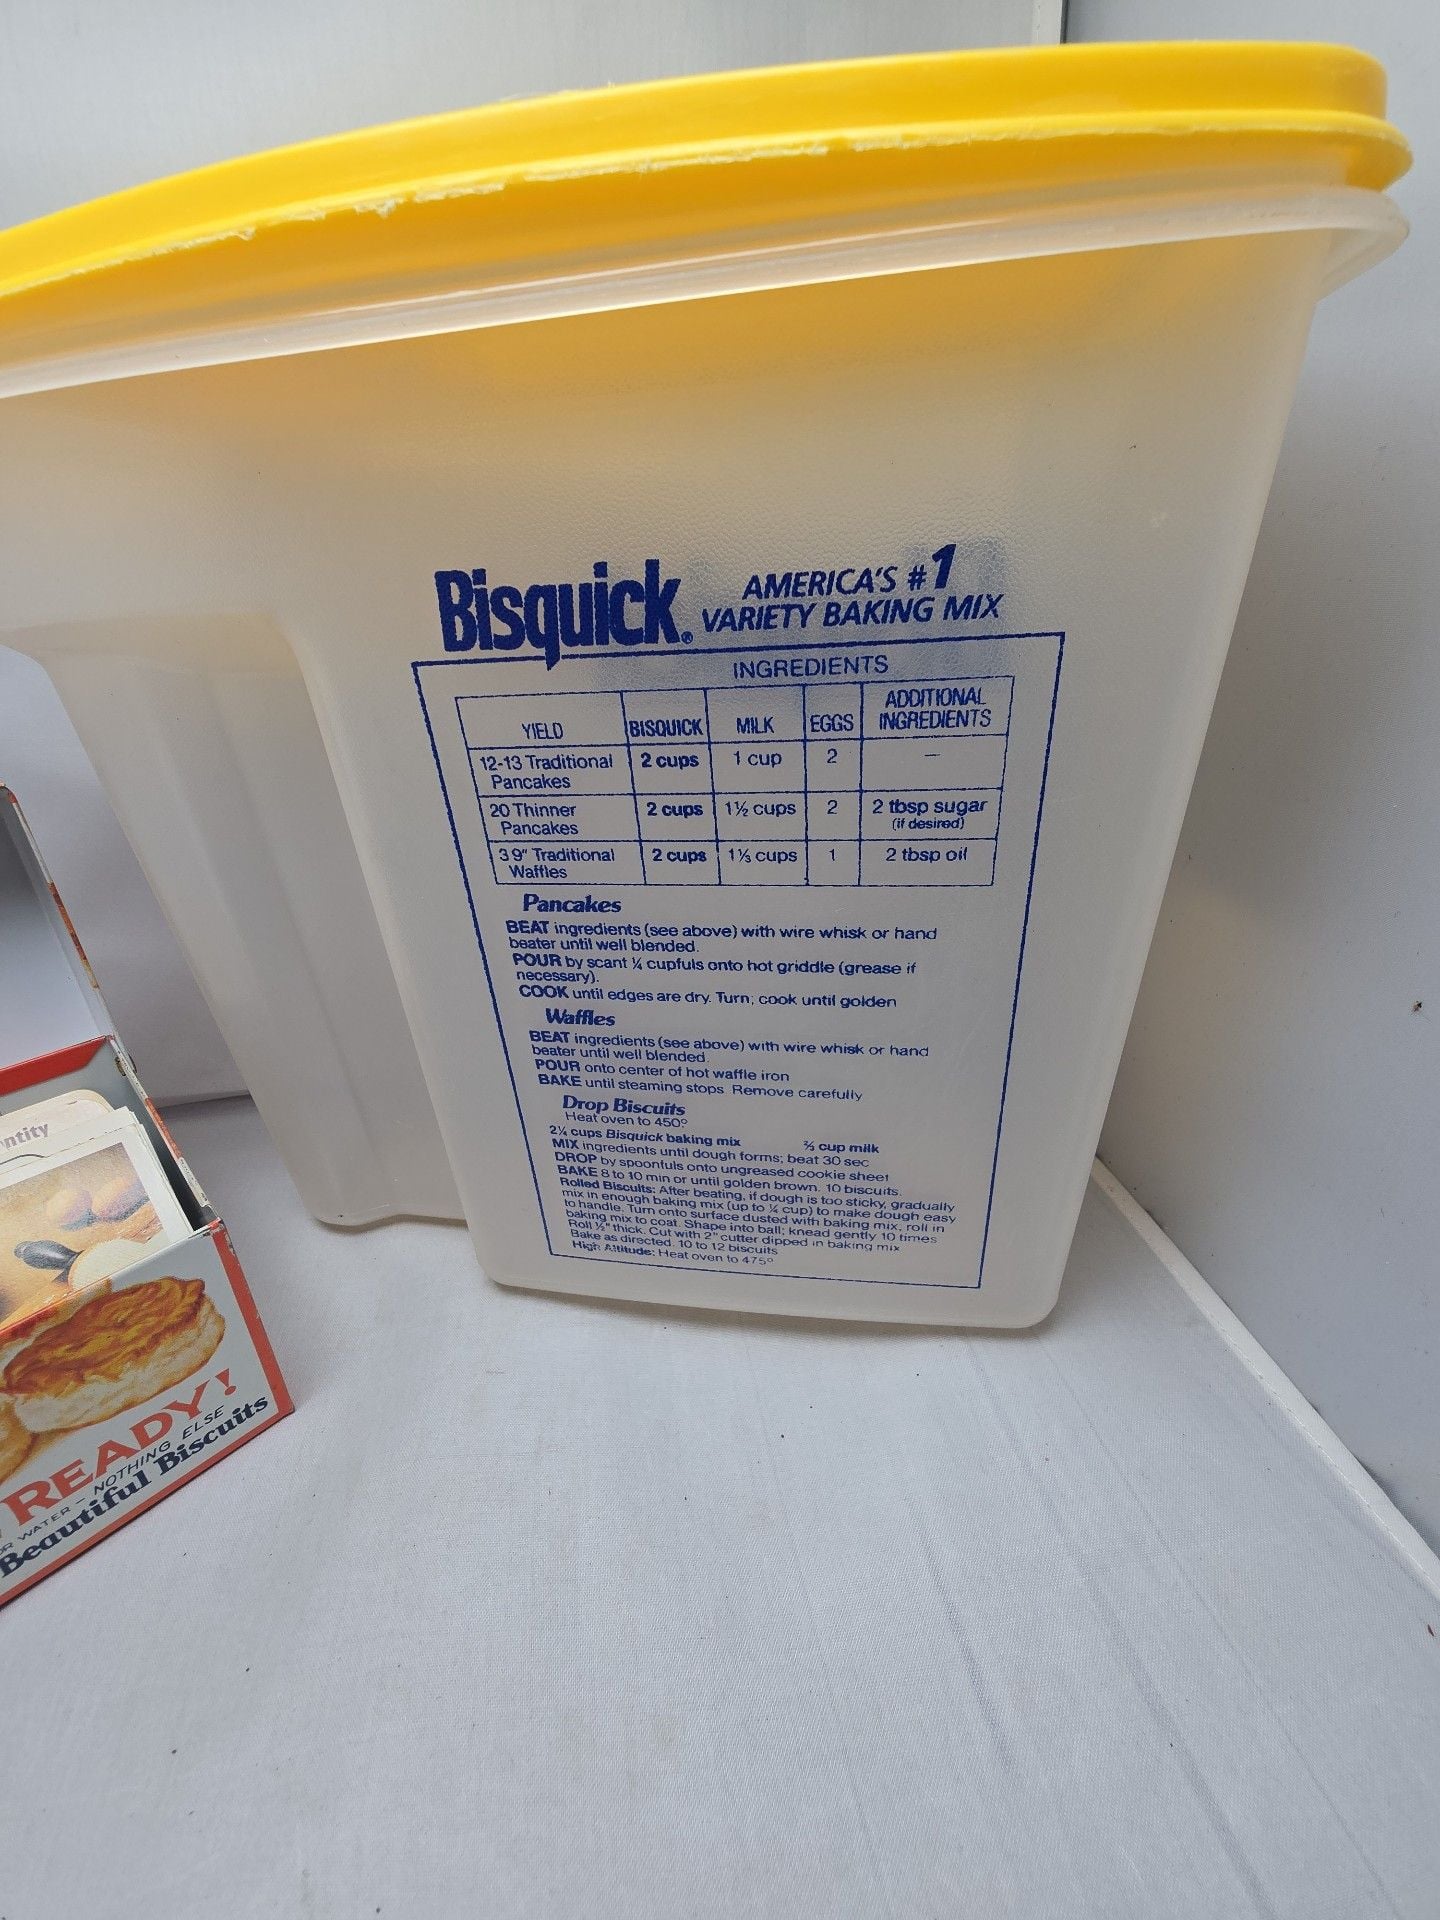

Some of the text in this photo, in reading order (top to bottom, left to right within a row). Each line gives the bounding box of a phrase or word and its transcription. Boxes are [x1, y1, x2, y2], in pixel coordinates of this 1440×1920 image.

[742, 543, 957, 600] AMERICA'S #1
[701, 594, 1005, 632] VARIETY BAKING MIX
[733, 655, 889, 679] INGREDIENTS
[885, 687, 987, 709] ADDITIONAL
[628, 718, 704, 738] BISQUICK
[736, 715, 775, 735] MILK
[810, 714, 854, 733] EGGS
[879, 708, 992, 731] INGREDIENTS
[521, 722, 564, 739] YIELD
[480, 753, 613, 771] 12-13 Traditional
[640, 752, 699, 769] 2 cups
[734, 752, 783, 768] 1 cup
[826, 749, 838, 764] 2
[490, 773, 571, 790] Pancakes
[490, 803, 577, 818] 20 Thinner
[646, 802, 704, 817] 2 cups
[753, 803, 797, 817] cups
[827, 800, 839, 815] 2
[872, 799, 989, 815] 2 tbsp sugar
[500, 820, 579, 836] Pancakes
[892, 817, 966, 831] (if desired)
[533, 847, 615, 862] Traditional
[652, 849, 708, 863] 2 cups
[755, 851, 798, 864] cups
[829, 849, 836, 862] 1
[885, 847, 968, 864] 2 tbsp oil
[508, 864, 568, 879] Waffles
[523, 893, 621, 912] Pancakes
[506, 920, 936, 939] BEAT ingredients (see above) with wire whisk or hand
[509, 936, 556, 949] beater
[560, 937, 592, 949] until
[596, 938, 626, 950] well
[512, 952, 562, 966] POUR
[565, 955, 582, 969] by
[586, 957, 627, 968] scant
[646, 957, 704, 971] cupfuls
[708, 960, 743, 971] onto
[747, 959, 772, 971] hot
[776, 960, 834, 974] griddle
[838, 961, 901, 975] (grease
[906, 962, 916, 973] if
[519, 984, 569, 998] COOK
[572, 987, 603, 999] until
[608, 989, 653, 1002] edges
[656, 992, 681, 1002] are
[684, 992, 711, 1004] dry.
[758, 993, 797, 1005] cook
[802, 994, 835, 1006] until
[840, 995, 896, 1008] golden
[546, 1008, 615, 1026] Waffles
[535, 1058, 789, 1081] POUR onto center of hot waffle iron
[538, 1073, 582, 1086] BAKE
[585, 1078, 614, 1088] until
[618, 1079, 682, 1093] steaming
[732, 1084, 793, 1097] Remove
[798, 1089, 862, 1101] carefully
[562, 1095, 685, 1115] Drop Biscuits
[565, 1111, 597, 1122] Heat
[600, 1115, 634, 1124] oven
[637, 1116, 650, 1125] to
[0, 1124, 48, 1150] ntity
[570, 1128, 602, 1138] cups
[606, 1129, 662, 1141] Bisquick
[666, 1133, 712, 1146] baking
[716, 1136, 740, 1146] mix
[552, 1138, 579, 1149] MIX
[582, 1142, 656, 1155] ingredients
[660, 1148, 688, 1157] until
[692, 1149, 735, 1161] dough
[787, 1153, 818, 1164] beat
[822, 1155, 840, 1165] 30
[818, 1143, 845, 1153] cup
[849, 1143, 878, 1153] milk
[554, 1151, 597, 1163] DROP
[600, 1156, 616, 1166] by
[619, 1159, 683, 1170] spoonfuls
[686, 1163, 717, 1172] onto
[720, 1166, 793, 1177] ungreased
[797, 1169, 845, 1179] cookie
[557, 1164, 597, 1177] BAKE
[601, 1168, 609, 1177] 8
[612, 1170, 624, 1179] to
[628, 1171, 642, 1180] 10
[646, 1174, 670, 1182] min
[690, 1176, 719, 1186] until
[723, 1178, 770, 1188] golden
[826, 1183, 840, 1192] 10
[559, 1177, 599, 1188] Rolled
[659, 1185, 689, 1196] After
[749, 1191, 756, 1200] if
[760, 1193, 802, 1203] dough
[807, 1194, 817, 1204] is
[821, 1196, 842, 1205] too
[890, 1201, 954, 1212] gradually
[17, 1506, 71, 1541] WATER
[94, 1440, 171, 1495] NOTHING
[182, 1405, 224, 1440] ELSE
[0, 1396, 269, 1577] Beautiful Biscuits
